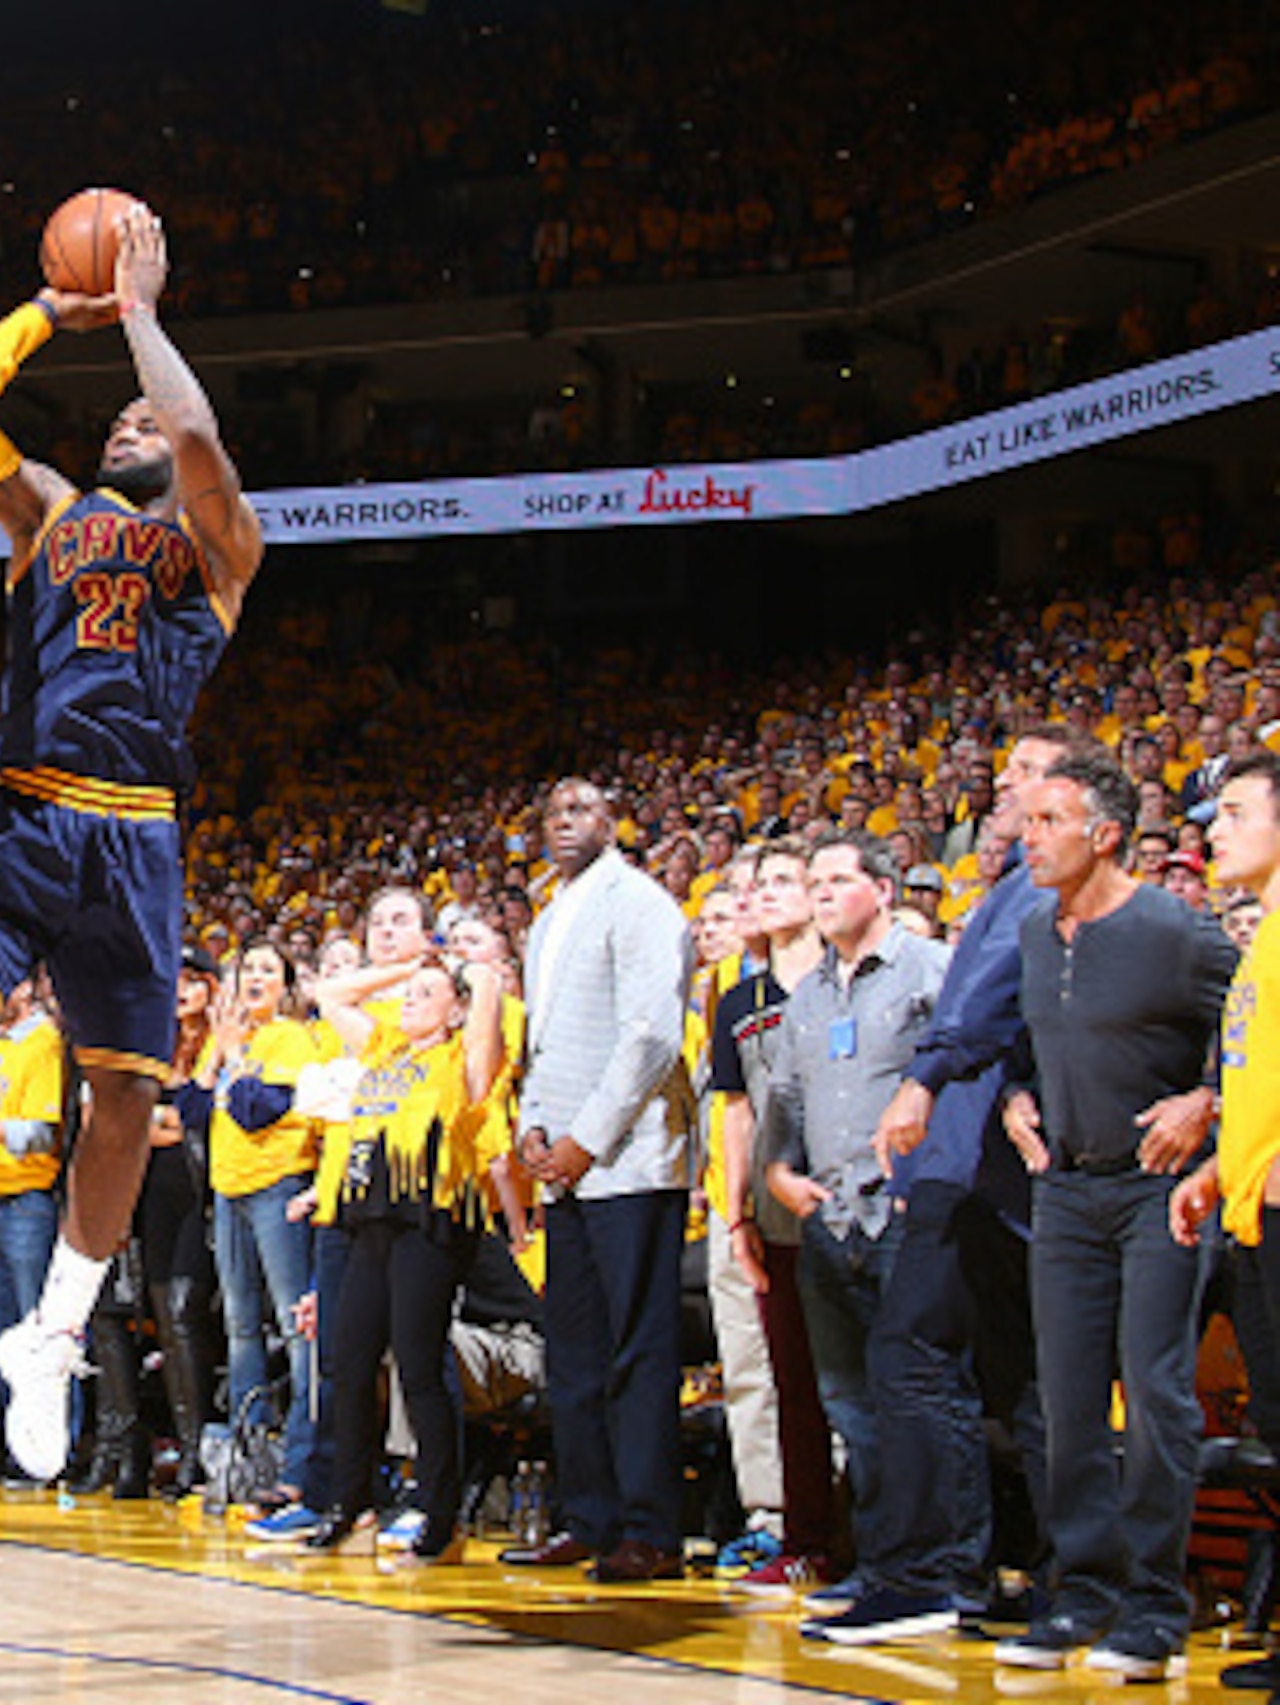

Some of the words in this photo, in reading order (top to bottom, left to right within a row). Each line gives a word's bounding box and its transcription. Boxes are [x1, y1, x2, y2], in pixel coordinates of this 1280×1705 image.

[944, 434, 990, 468] EAT
[998, 414, 1057, 452] LIKE
[1062, 369, 1222, 431] WARRIORS.
[282, 499, 471, 528] WARRIORS.
[524, 492, 591, 518] SHOP
[596, 489, 626, 512] AT
[639, 469, 760, 517] Lucky
[45, 511, 193, 600] CAVS
[72, 571, 151, 652] 23
